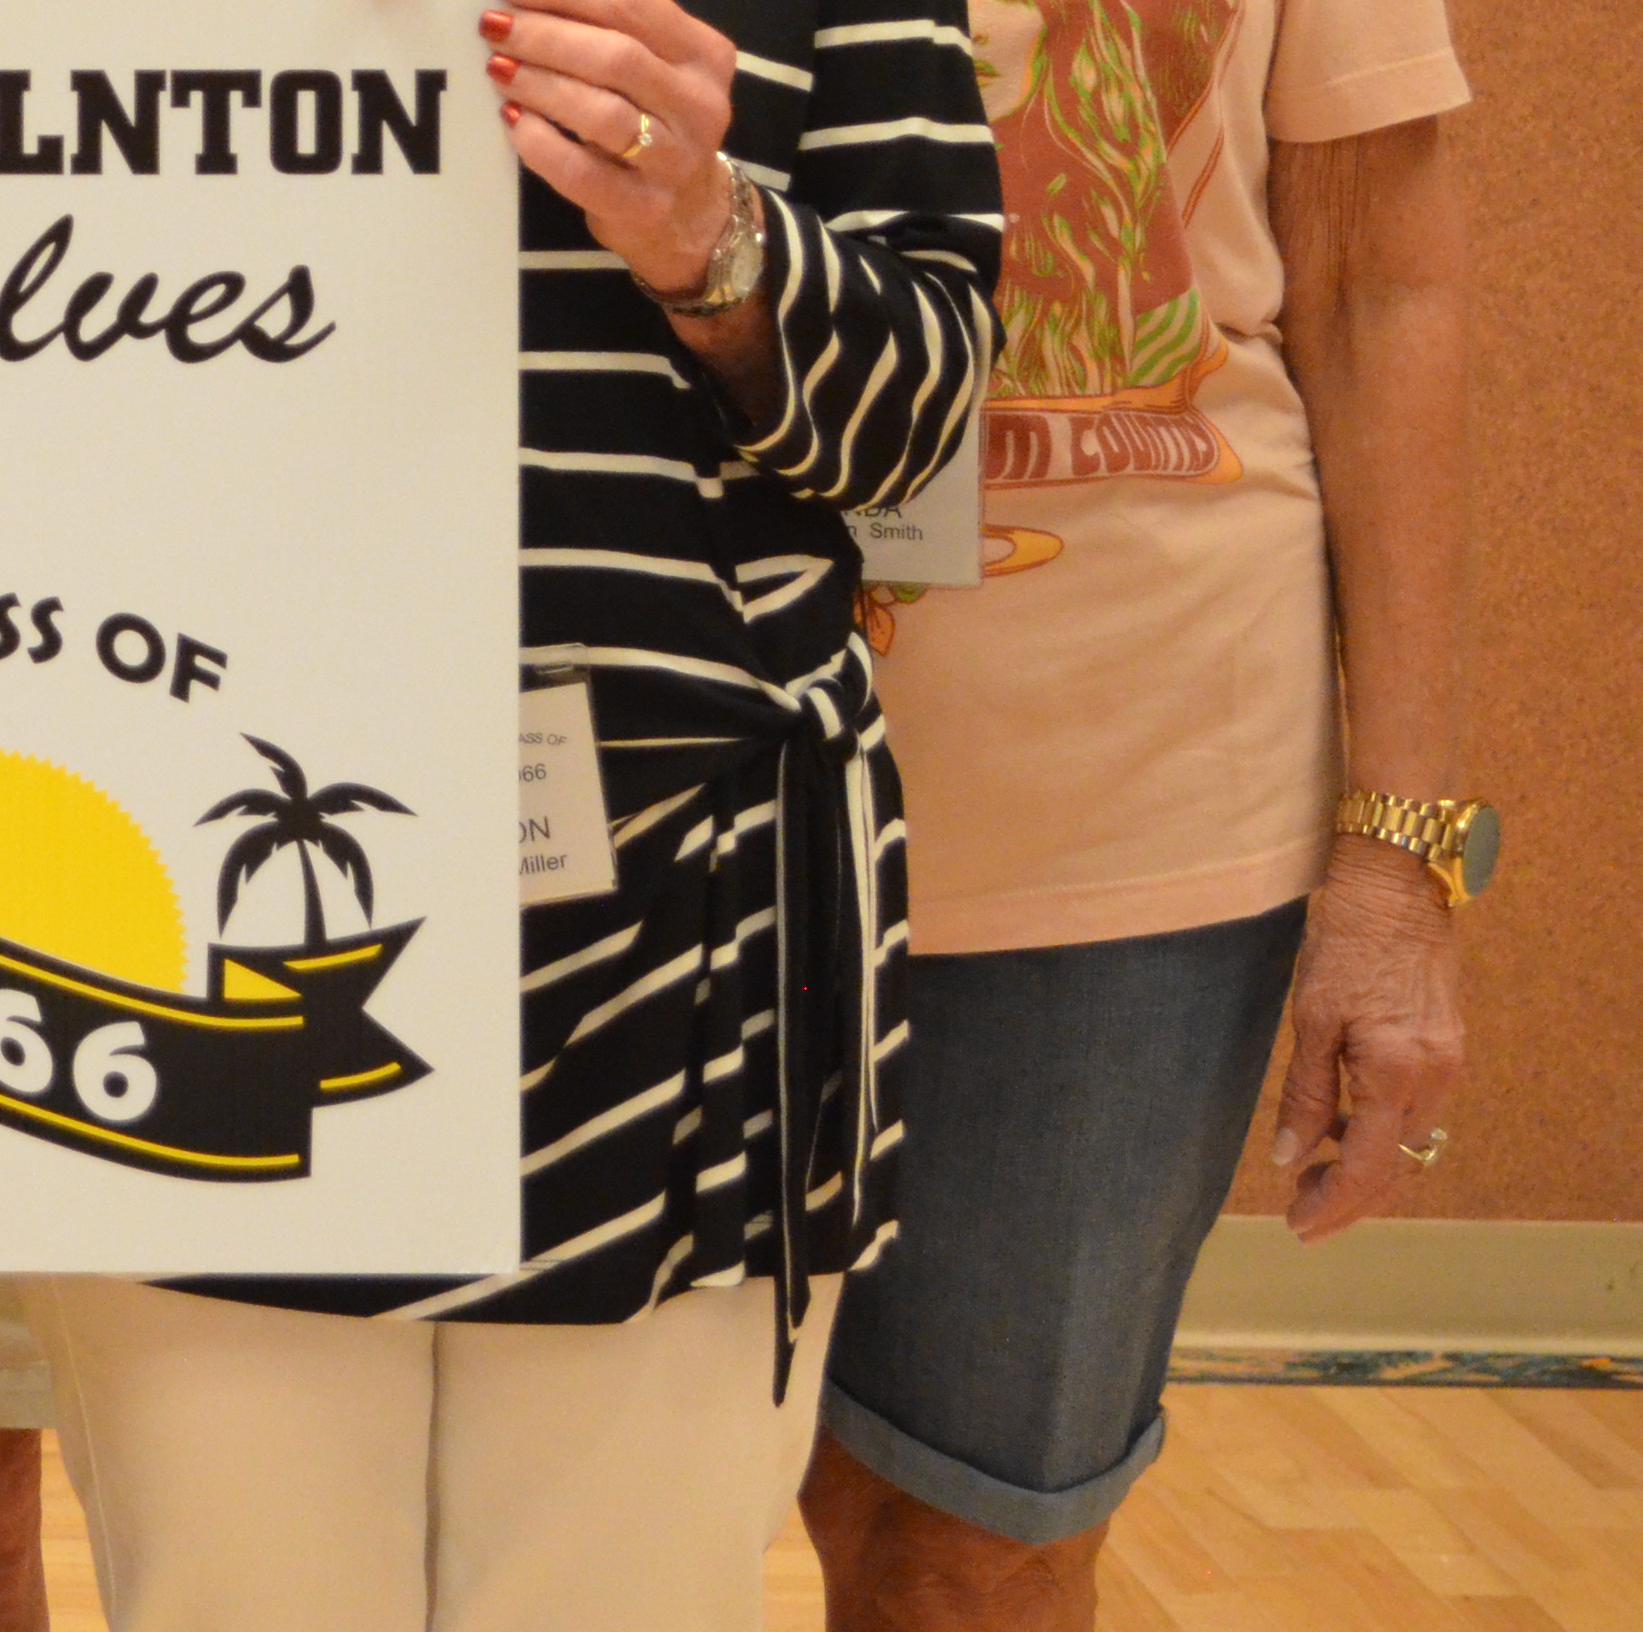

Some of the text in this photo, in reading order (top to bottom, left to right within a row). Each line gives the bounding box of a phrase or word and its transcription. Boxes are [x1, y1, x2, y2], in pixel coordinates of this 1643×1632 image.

[870, 522, 923, 541] Smith
[96, 613, 227, 703] OF
[546, 733, 568, 746] OF
